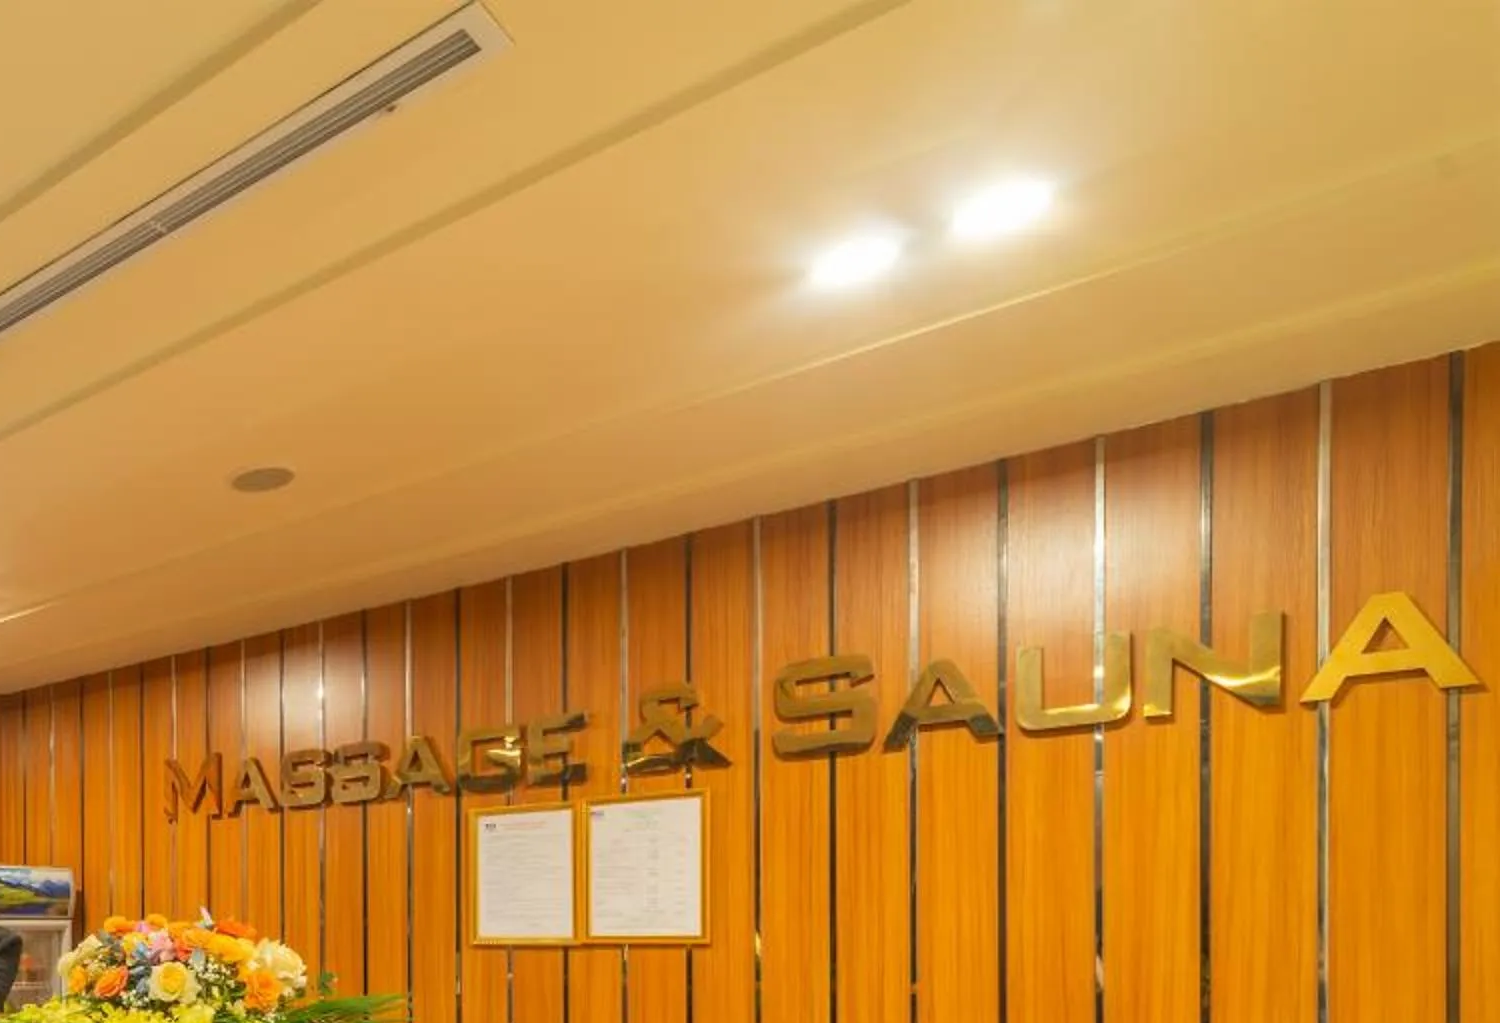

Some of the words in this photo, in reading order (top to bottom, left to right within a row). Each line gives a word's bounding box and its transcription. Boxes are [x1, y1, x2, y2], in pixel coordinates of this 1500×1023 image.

[164, 712, 588, 823] MASSAGE
[623, 684, 732, 772] &
[772, 591, 1481, 756] SAUNA
